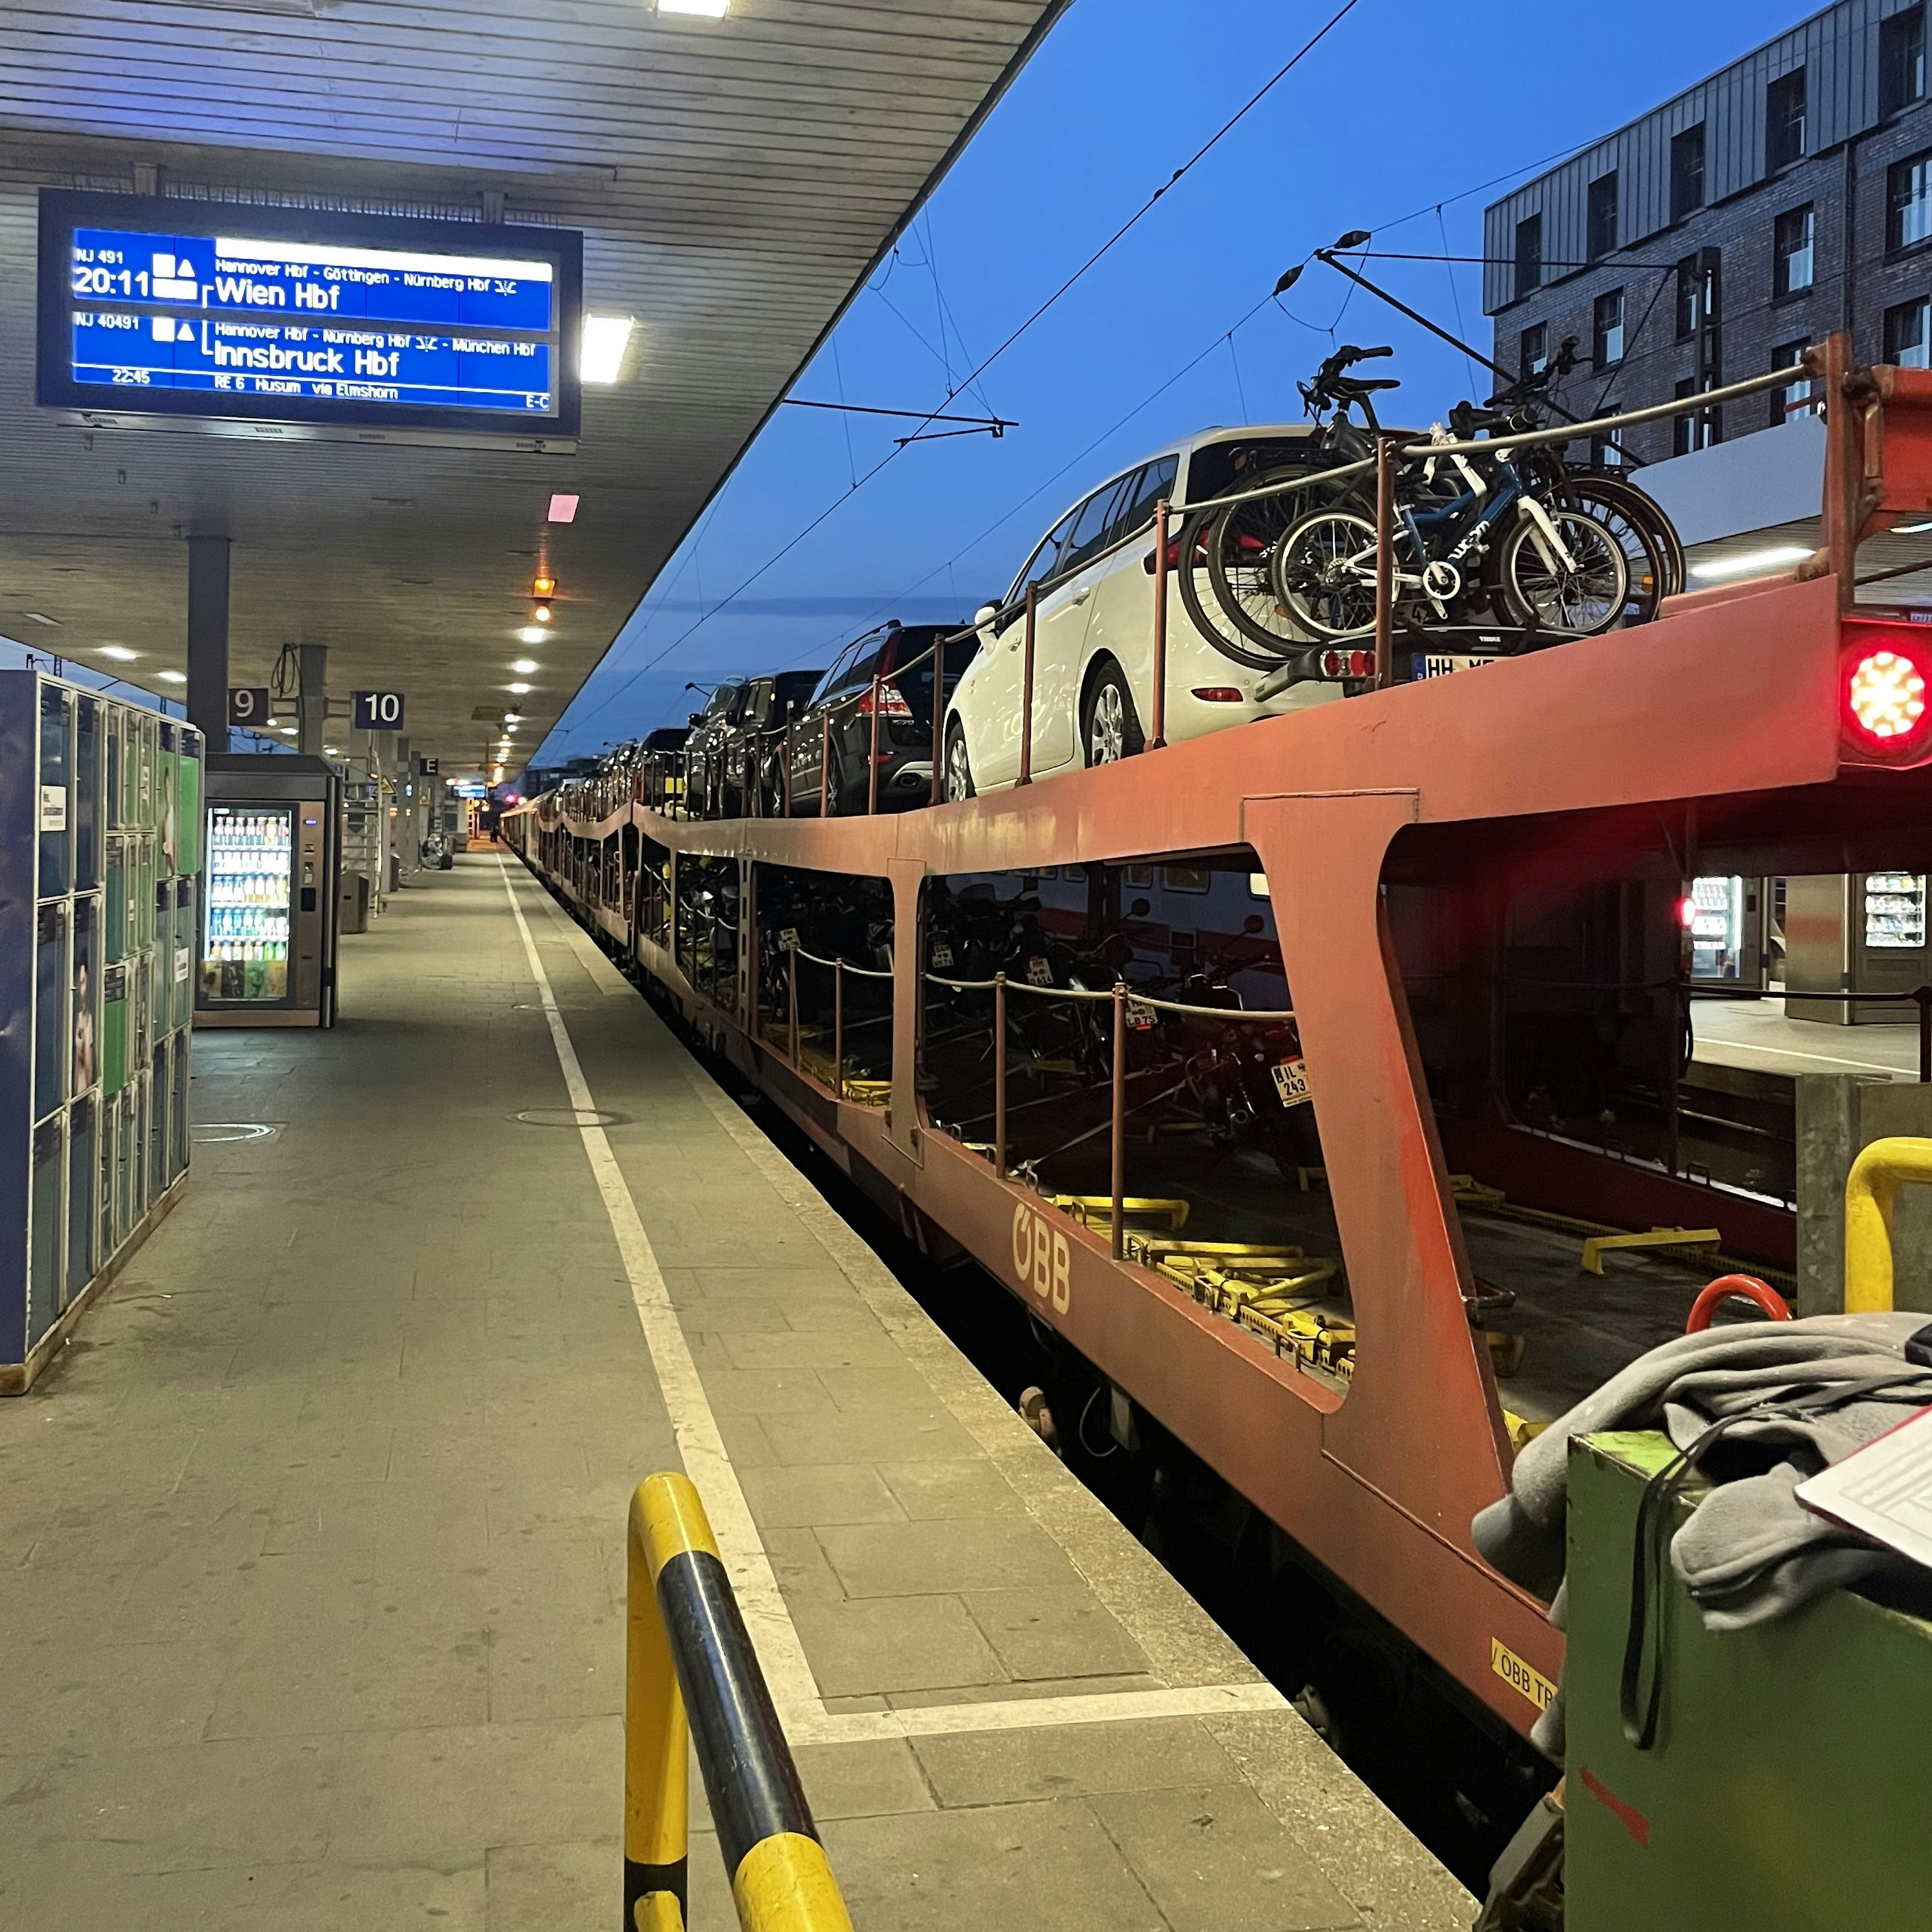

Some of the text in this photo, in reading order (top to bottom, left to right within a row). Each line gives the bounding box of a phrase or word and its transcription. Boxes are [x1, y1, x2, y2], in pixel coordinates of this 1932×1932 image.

[76, 249, 123, 264] NJ 491
[74, 267, 148, 296] 20:11
[215, 259, 280, 276] Hannover
[285, 265, 308, 278] Hbf
[324, 267, 389, 285] Göttingen
[404, 273, 464, 291] Nürnberg
[467, 278, 491, 292] Hbf
[215, 277, 340, 310] Wien Hbf
[76, 313, 139, 330] NJ 40491
[215, 323, 280, 339] Hannover
[285, 328, 308, 341] Hbf
[323, 330, 384, 348] Nürnberg
[388, 334, 411, 348] Hbf
[452, 339, 510, 355] München
[513, 343, 535, 356] Hbf
[214, 340, 399, 376] Innsbruck Hbf
[112, 370, 150, 384] 22:45
[214, 376, 398, 399] RE 6 Husum via Elmshorn
[526, 395, 549, 409] E-C
[1428, 659, 1453, 678] HH
[235, 690, 254, 717] 9
[365, 693, 399, 722] 10
[427, 759, 436, 772] E
[1284, 1066, 1297, 1080] IL
[1283, 1079, 1306, 1096] 243
[1013, 1203, 1070, 1315] ÖBB
